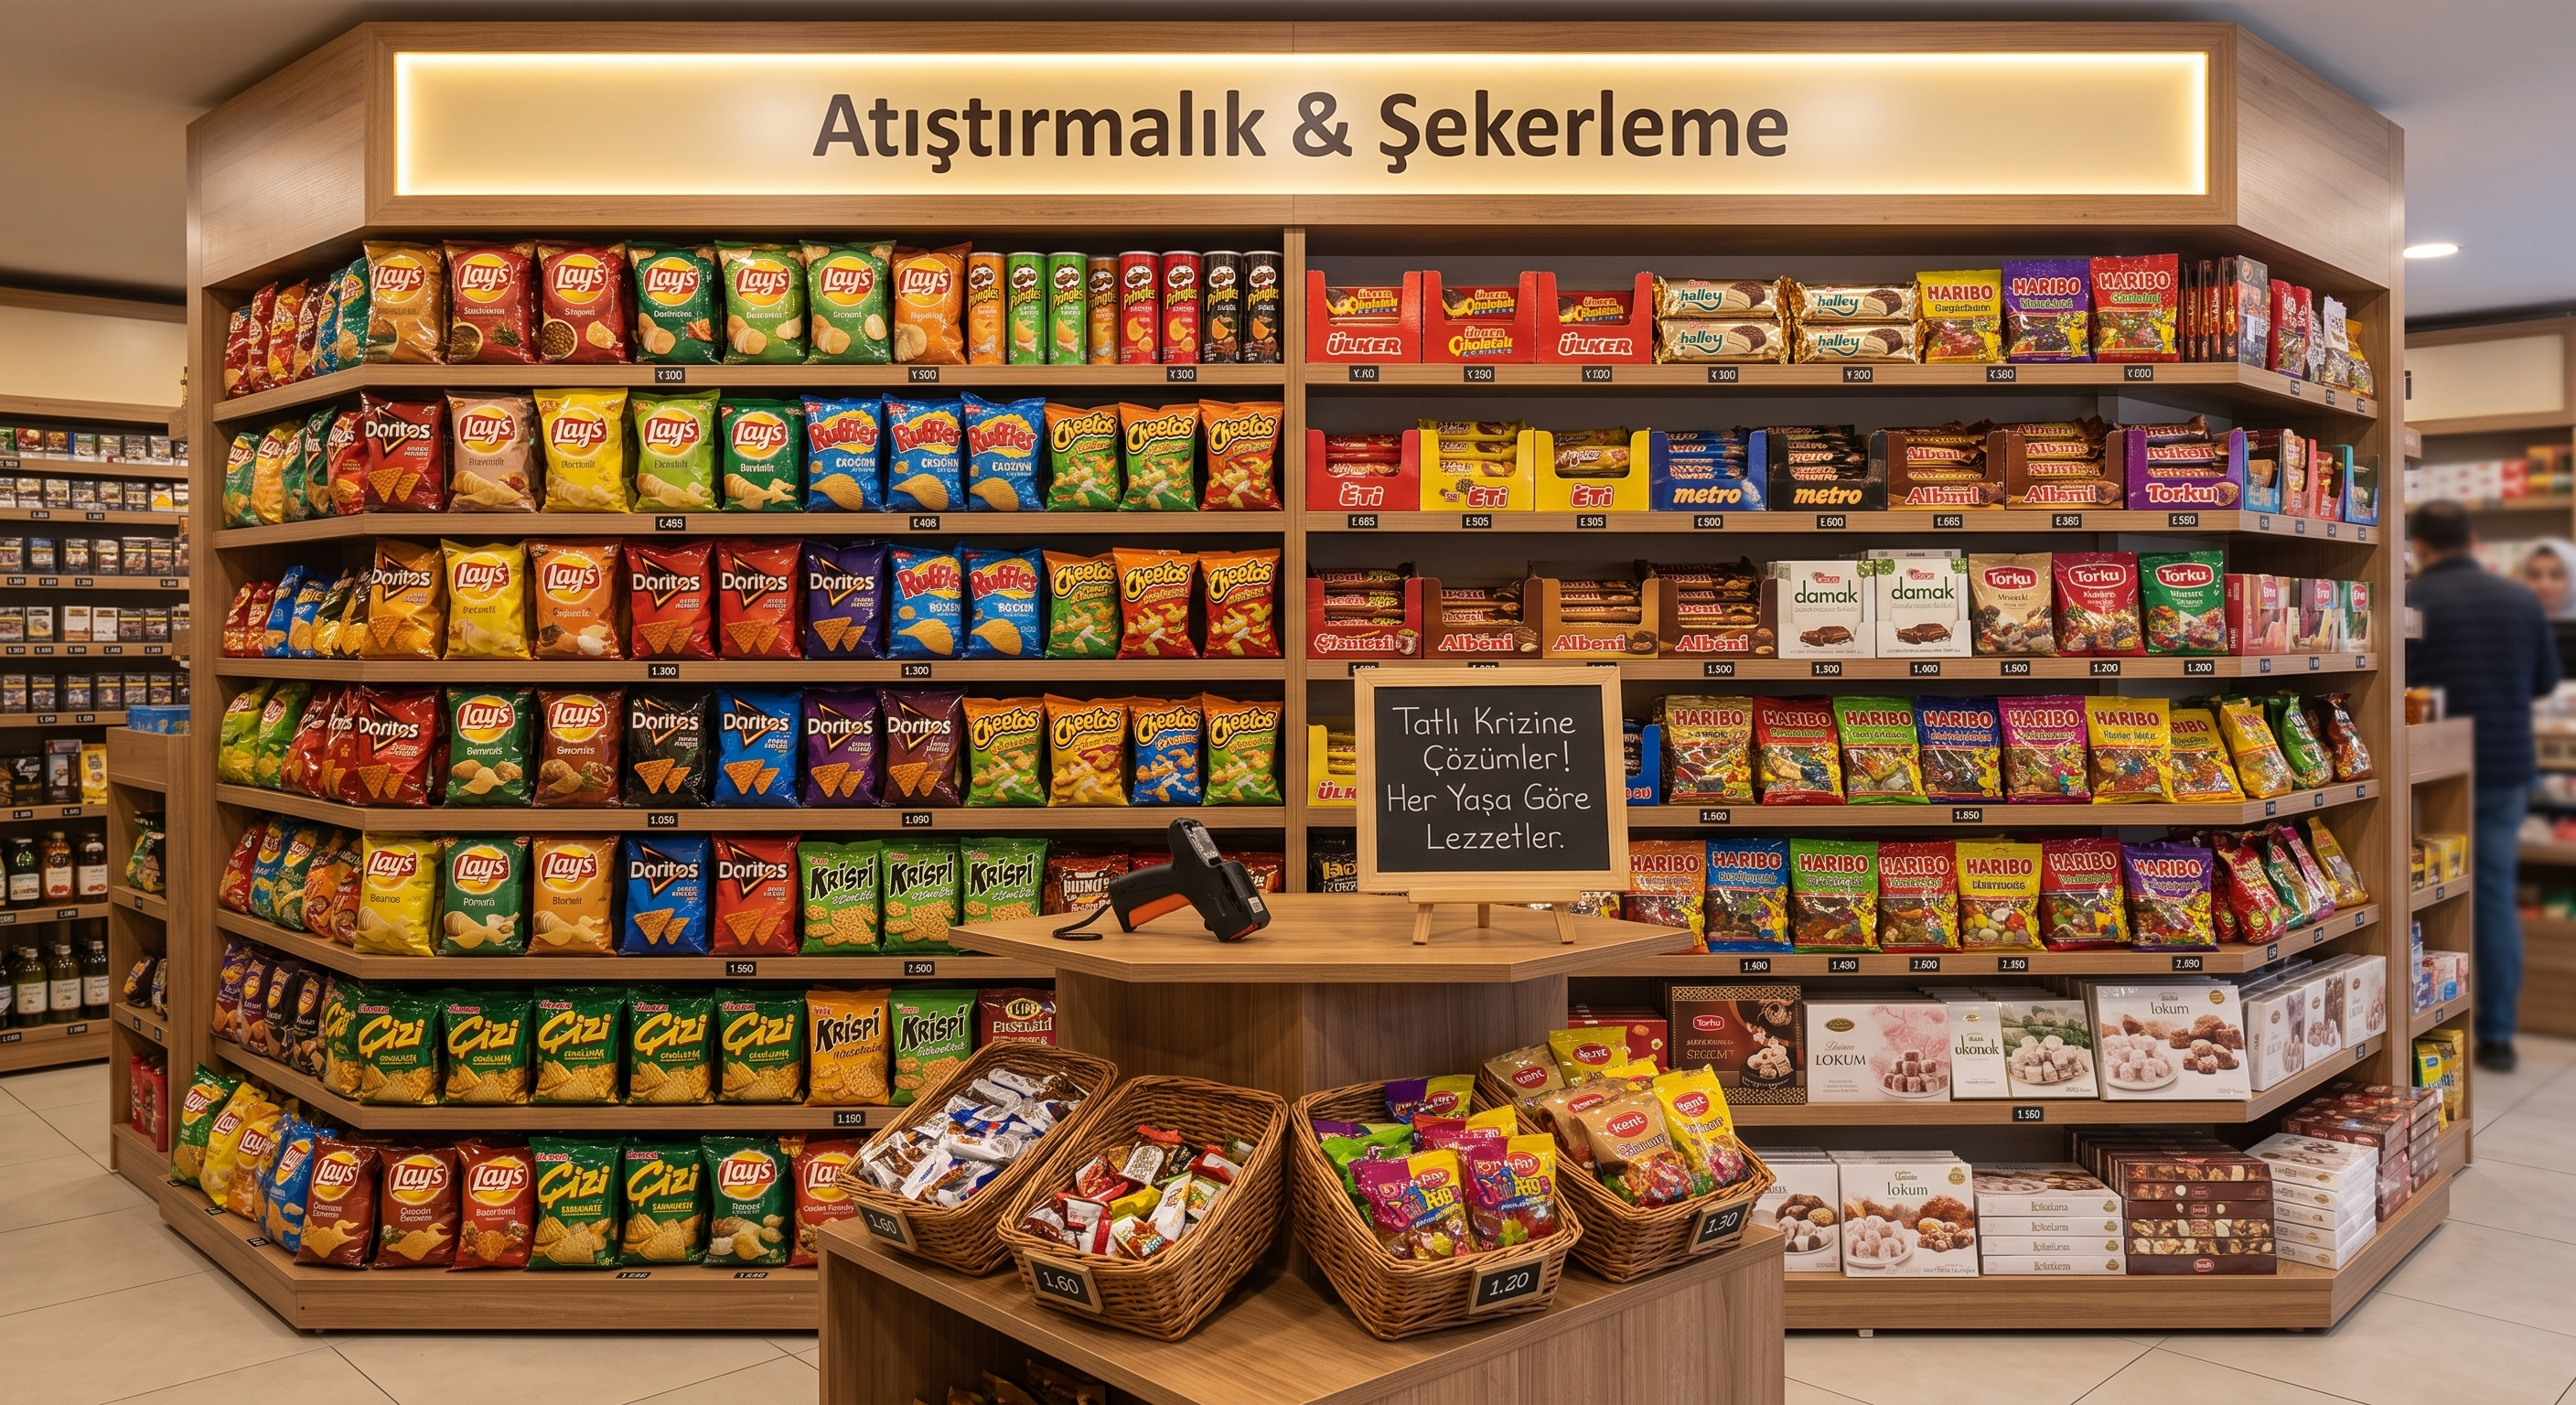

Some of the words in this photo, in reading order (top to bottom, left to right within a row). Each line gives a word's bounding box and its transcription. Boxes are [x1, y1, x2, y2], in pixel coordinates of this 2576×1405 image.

[812, 89, 1266, 175] Atıştırmalık
[1292, 91, 1352, 157] &
[1378, 89, 1788, 175] Şekerleme
[2013, 278, 2081, 297] HARIBO
[2098, 272, 2170, 292] HARIBO
[1680, 289, 1723, 310] halley
[1928, 285, 1992, 302] HARIBO
[1818, 295, 1859, 316] halley
[1326, 331, 1401, 356] ÜLKER
[1559, 331, 1633, 356] ÜLKER
[1680, 332, 1723, 354] halley
[1818, 334, 1860, 355] halley
[365, 420, 430, 441] Doritos
[1053, 413, 1116, 452] Cheetos
[1127, 415, 1193, 455] Cheetos
[1209, 413, 1277, 453] Cheetos
[1673, 487, 1742, 504] metro
[1794, 487, 1862, 505] metro
[372, 568, 431, 587] Doritos
[633, 574, 700, 592] Doritos
[722, 574, 788, 591] Doritos
[810, 574, 875, 591] Doritos
[1054, 561, 1115, 597] Cheetos
[1123, 561, 1190, 600] Cheetos
[1208, 560, 1273, 600] Cheetos
[1989, 571, 2032, 587] Torku
[2075, 569, 2120, 582] Torku
[2164, 569, 2206, 582] Torku
[1795, 580, 1857, 604] damak
[1892, 577, 1954, 600] damak
[1439, 633, 1514, 651] Albeni
[1553, 635, 1625, 651] Albeni
[1677, 635, 1748, 651] Albeni
[652, 667, 676, 675] 1.300
[906, 667, 928, 675] 1.300
[2005, 664, 2027, 672] 1.500
[2094, 664, 2118, 672] 1.200
[2188, 663, 2212, 671] 1.200
[359, 717, 418, 738] Doritos
[632, 713, 698, 730] Doritos
[724, 713, 789, 732] Doritos
[808, 717, 872, 735] Doritos
[888, 717, 950, 735] Doritos
[1054, 707, 1120, 748] Cheetos
[1136, 707, 1200, 748] Cheetos
[1211, 707, 1278, 748] Cheetos
[1392, 707, 1458, 735] Tatlı
[1476, 707, 1576, 735] Krizine
[1675, 710, 1744, 726] HARIBO
[1764, 711, 1830, 727] HARIBO
[1845, 711, 1911, 726] HARIBO
[1925, 712, 1991, 729] HARIBO
[2010, 710, 2077, 728] HARIBO
[2094, 711, 2159, 726] HARIBO
[2170, 719, 2209, 735] RIBO
[972, 708, 1039, 749] Cheetos
[1317, 782, 1356, 800] ÜLK
[1388, 784, 1437, 811] Her
[1447, 783, 1511, 816] Yaşa
[1524, 783, 1592, 810] Göre
[1427, 823, 1564, 850] Lezzetler.
[630, 862, 698, 879] Doritos
[719, 862, 787, 879] Doritos
[1630, 855, 1699, 872] HARIBO
[1713, 853, 1782, 870] HARIBO
[1800, 854, 1869, 874] HARIBO
[1880, 856, 1949, 874] HARIBO
[1966, 858, 2033, 876] HARIBO
[2050, 852, 2117, 872] HARIBO
[2134, 858, 2200, 877] HARIBO
[2151, 1002, 2189, 1015] lokum
[359, 1014, 424, 1057] Çizi
[447, 1016, 521, 1057] Çizi
[537, 1012, 613, 1056] Çizi
[634, 1013, 707, 1055] Çizi
[723, 1013, 795, 1055] Çizi
[1815, 1054, 1866, 1066] LOKUM
[1612, 1115, 1645, 1133] kent
[538, 1161, 610, 1209] Çizi
[628, 1159, 700, 1206] Çizi
[1887, 1182, 1928, 1196] lokum
[872, 1215, 896, 1234] 1.60
[1708, 1214, 1738, 1233] 1.30
[1043, 1271, 1079, 1294] 1.60
[1489, 1272, 1530, 1296] 1.20
